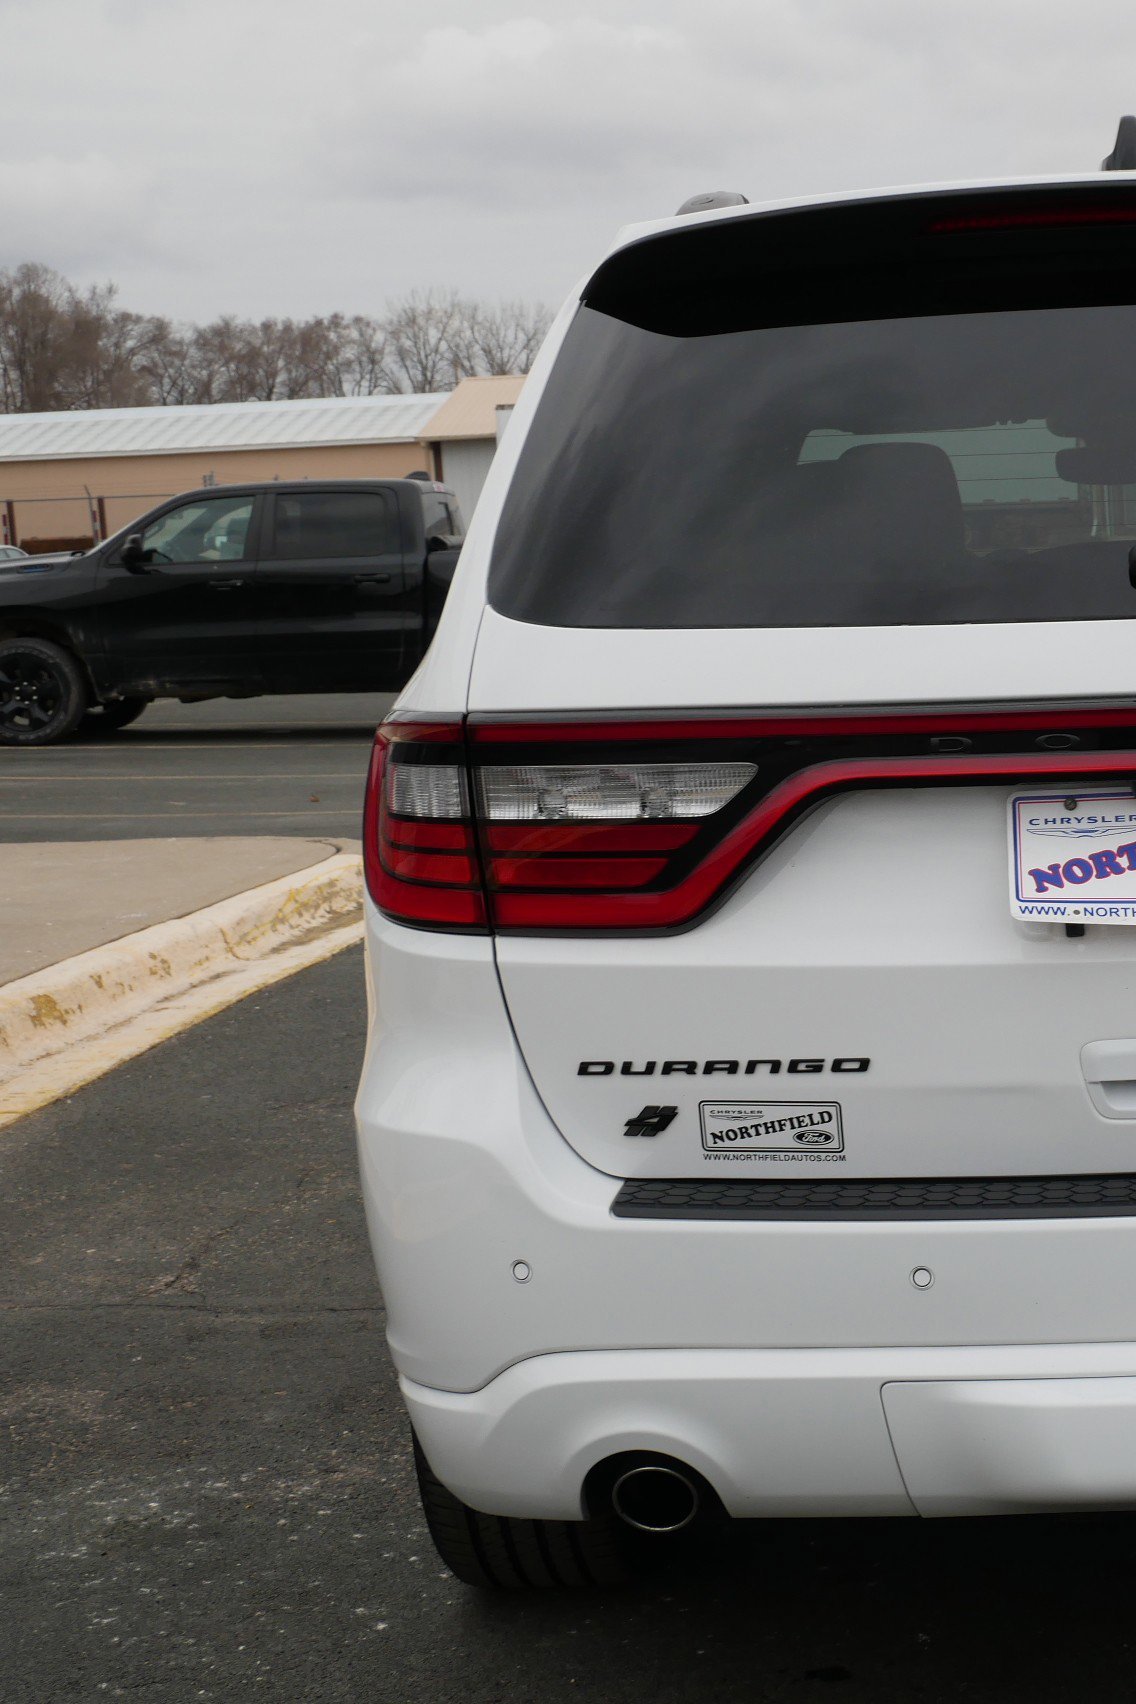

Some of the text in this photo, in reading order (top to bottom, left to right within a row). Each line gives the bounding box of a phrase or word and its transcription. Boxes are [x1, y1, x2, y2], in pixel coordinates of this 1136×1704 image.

[577, 1058, 871, 1076] DURANGO
[710, 1110, 834, 1145] NORTHFIELD
[703, 1154, 847, 1162] WWW.NORTHFIELDAUTOS.COM
